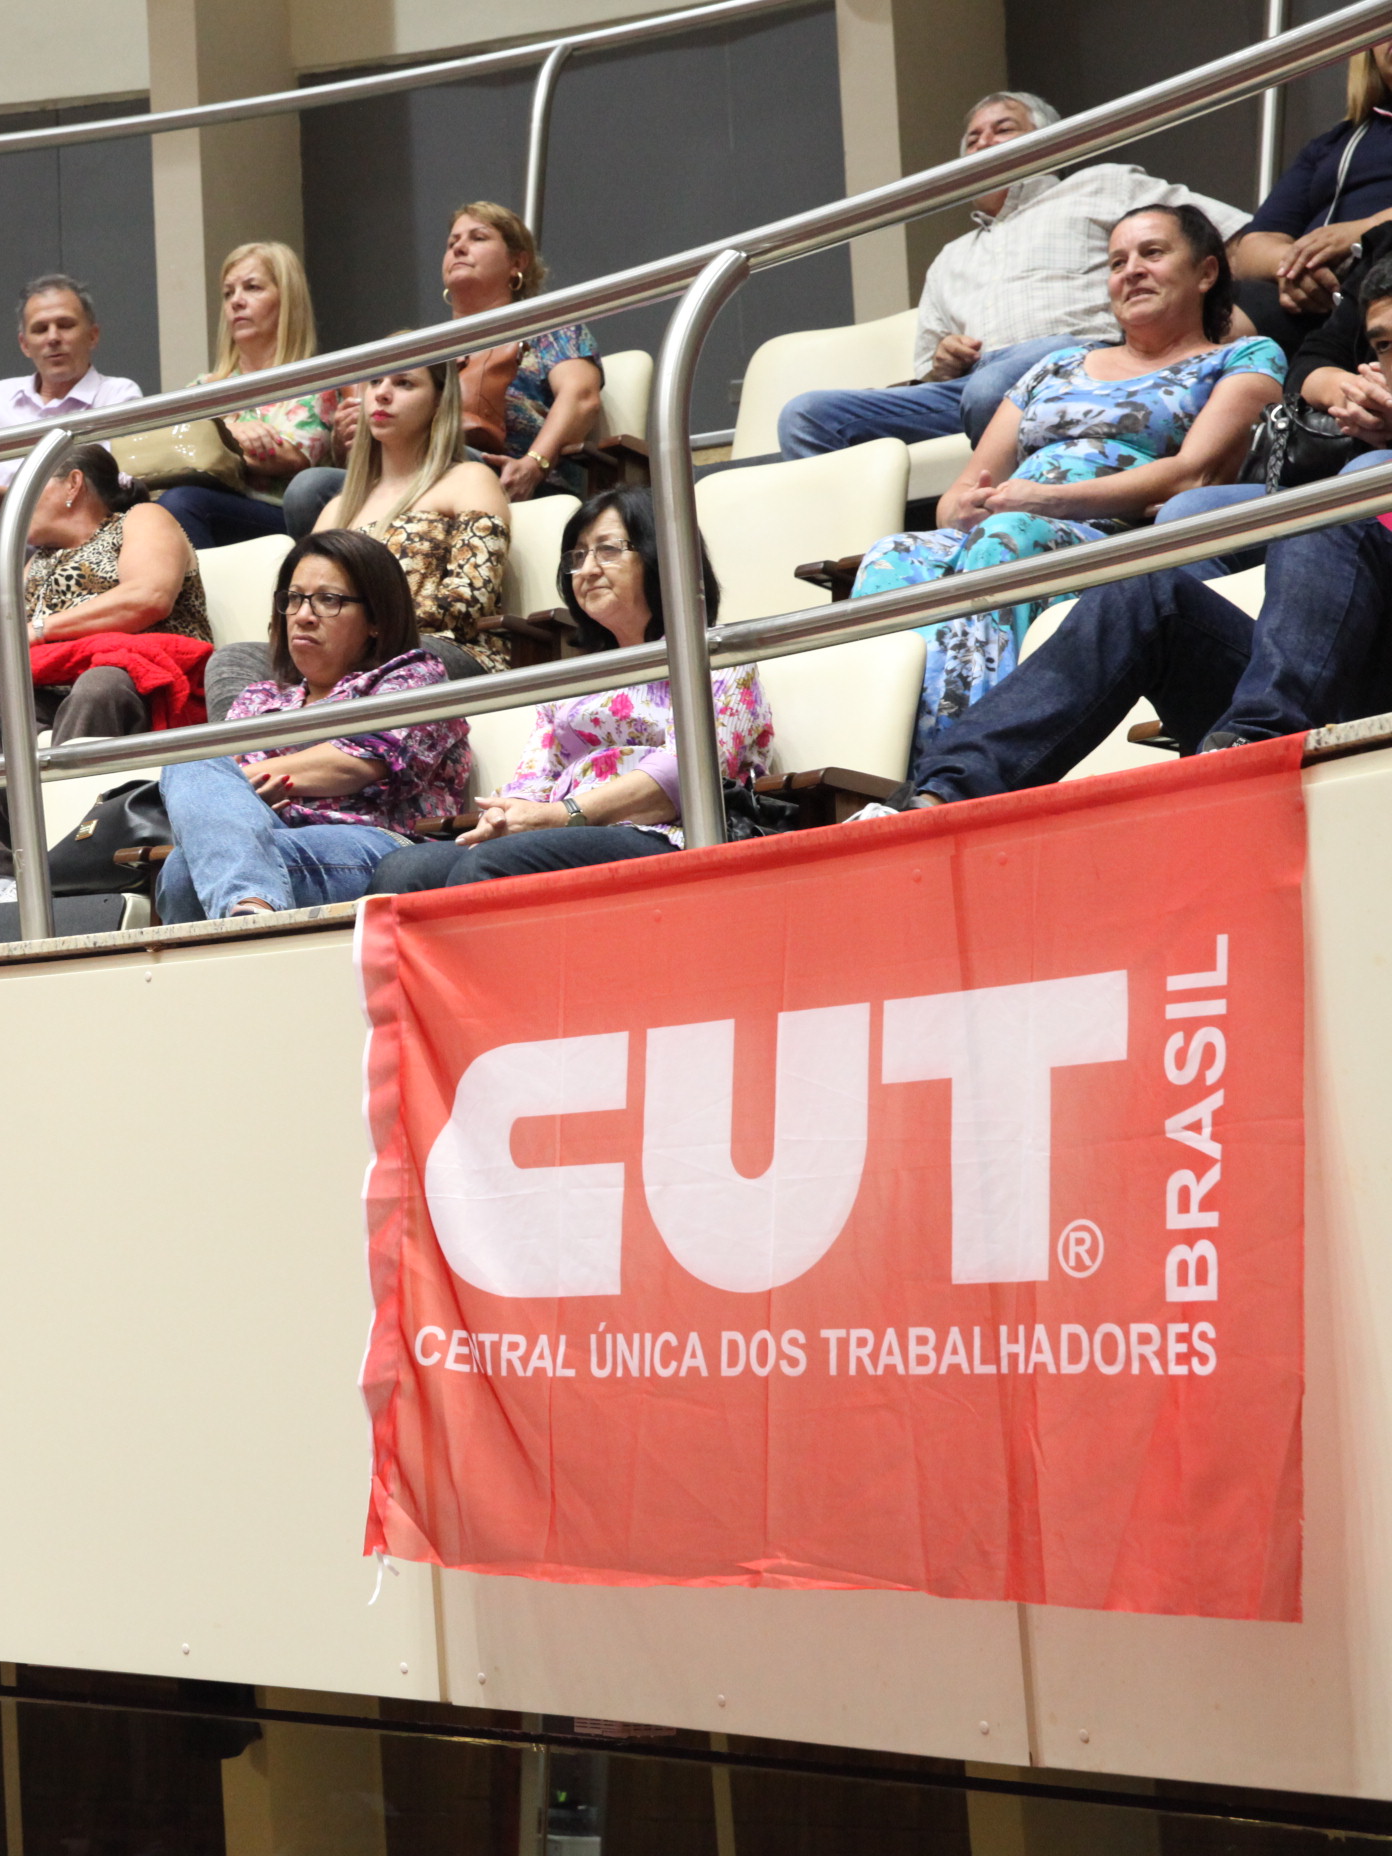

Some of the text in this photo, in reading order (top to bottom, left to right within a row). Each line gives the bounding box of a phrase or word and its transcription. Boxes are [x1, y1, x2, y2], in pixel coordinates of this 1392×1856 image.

[424, 969, 1129, 1299] CUT
[1163, 933, 1229, 1303] BRASIL
[414, 1321, 1217, 1378] CENTRAL ÚNICA DOS TRABALHADORES
